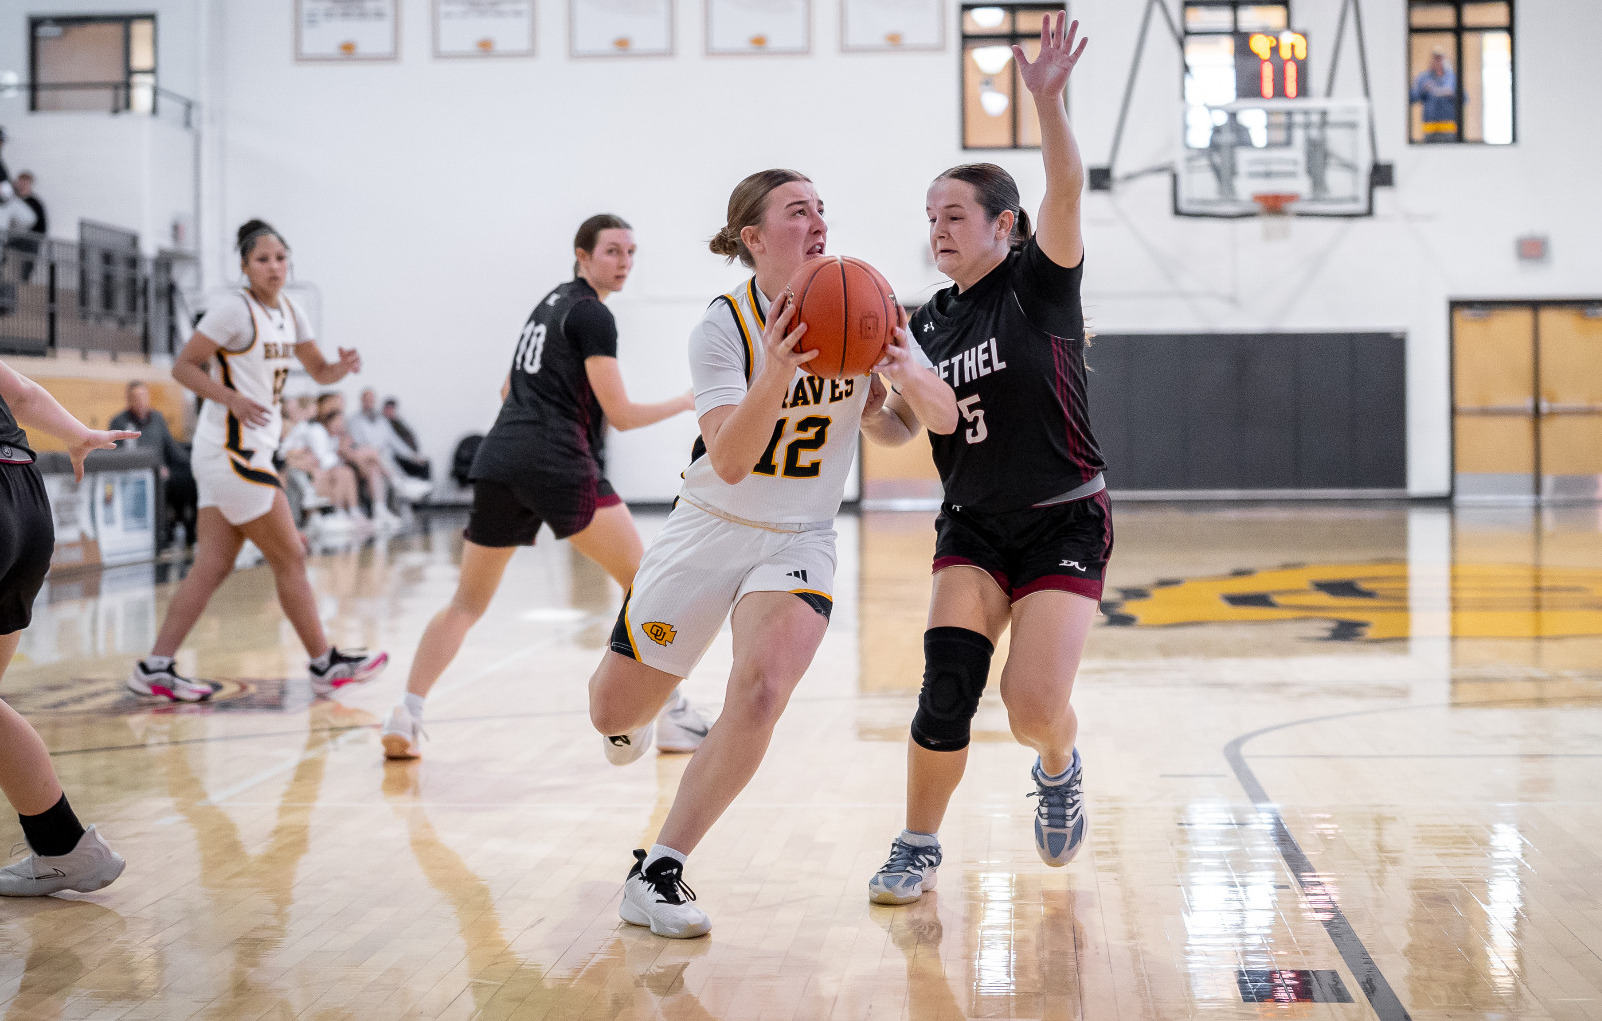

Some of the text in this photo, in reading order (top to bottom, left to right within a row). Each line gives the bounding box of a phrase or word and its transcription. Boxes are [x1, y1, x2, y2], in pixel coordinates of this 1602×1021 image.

[933, 337, 1007, 388] ETHEL
[957, 393, 988, 445] 5
[751, 414, 832, 480] 12
